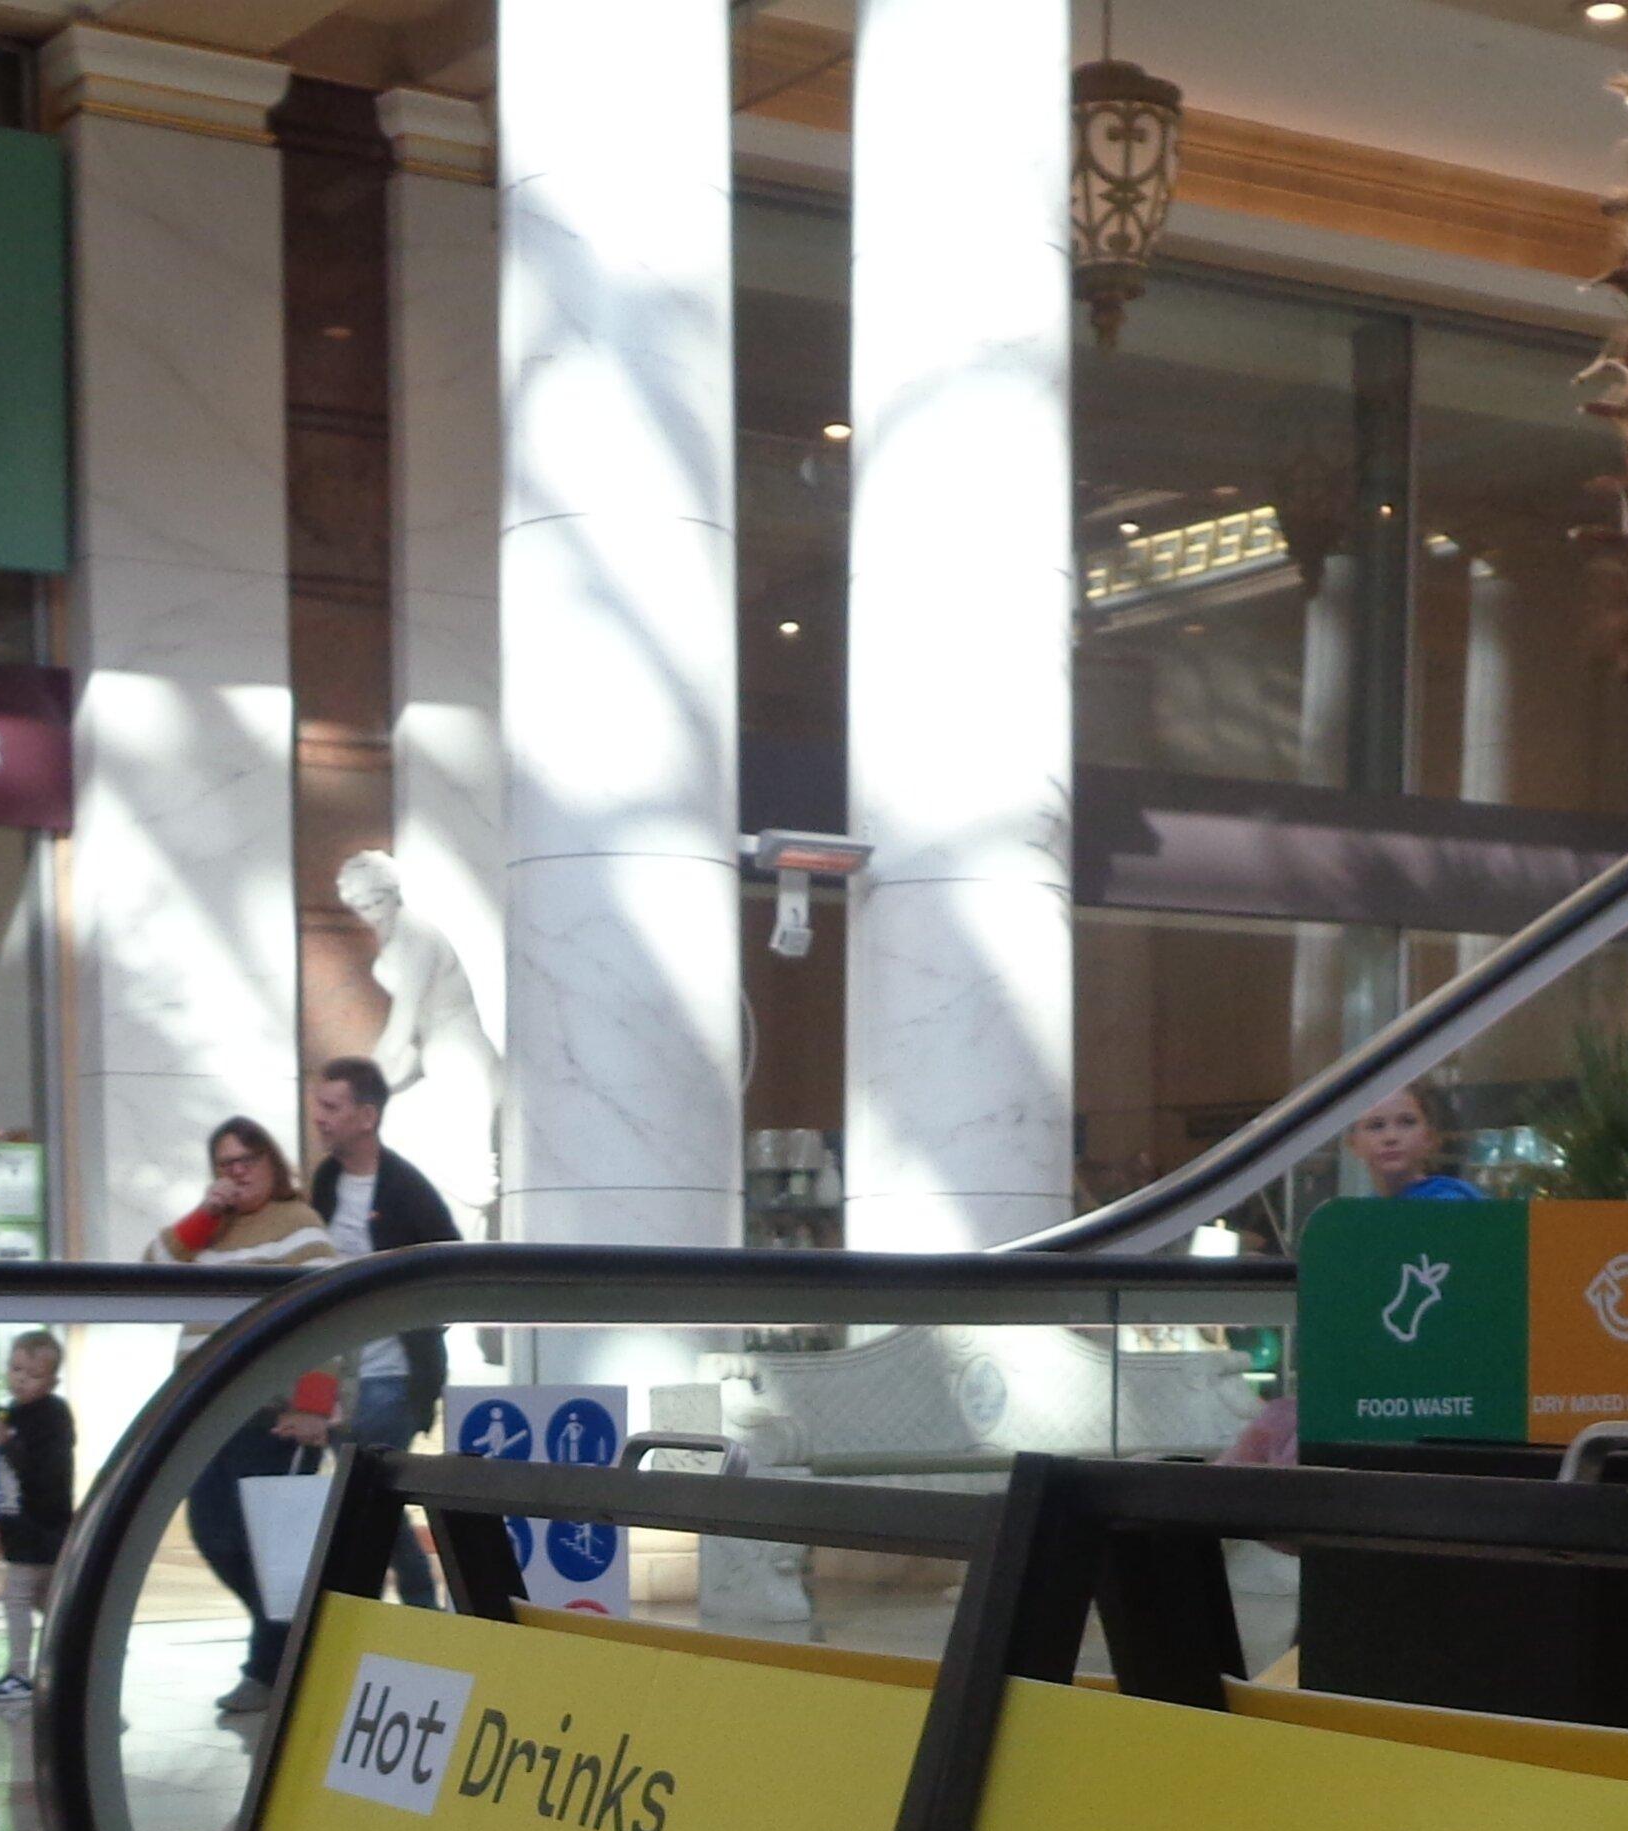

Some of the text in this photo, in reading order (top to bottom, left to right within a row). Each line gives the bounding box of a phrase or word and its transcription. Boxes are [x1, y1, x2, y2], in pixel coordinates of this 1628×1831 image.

[1357, 1397, 1473, 1417] FOOD WASTE
[1533, 1394, 1566, 1413] DRY
[1571, 1394, 1622, 1412] MIXED
[341, 1680, 446, 1786] Hot
